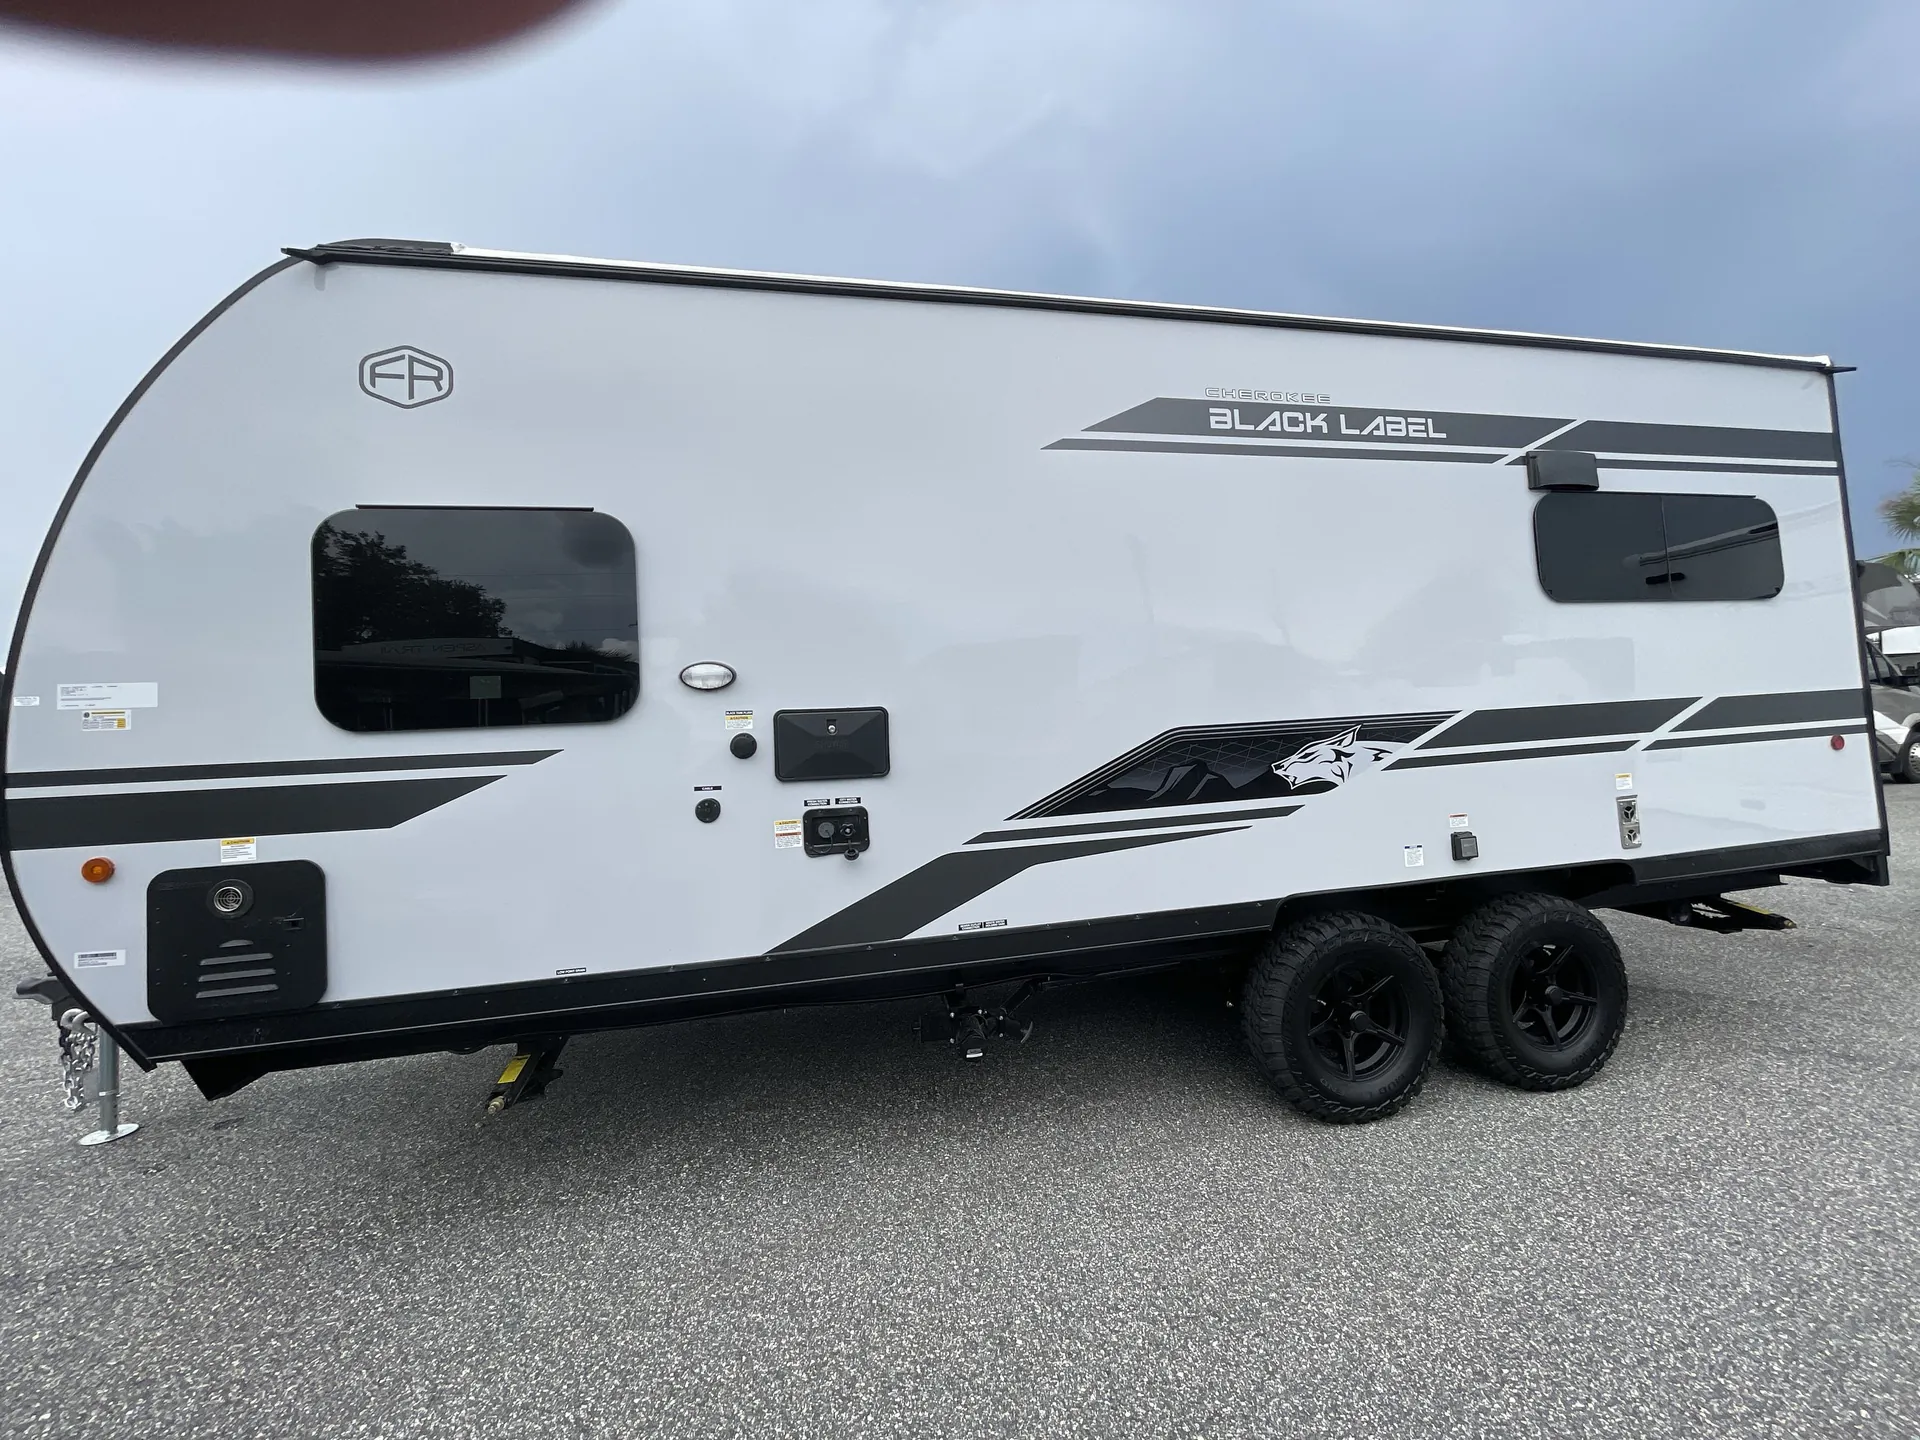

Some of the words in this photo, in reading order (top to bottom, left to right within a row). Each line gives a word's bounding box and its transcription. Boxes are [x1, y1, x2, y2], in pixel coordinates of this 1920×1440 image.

[370, 354, 444, 401] FR
[1204, 387, 1331, 404] CHEROKEE
[1208, 407, 1329, 434] BLACK
[1339, 413, 1447, 439] LABEL
